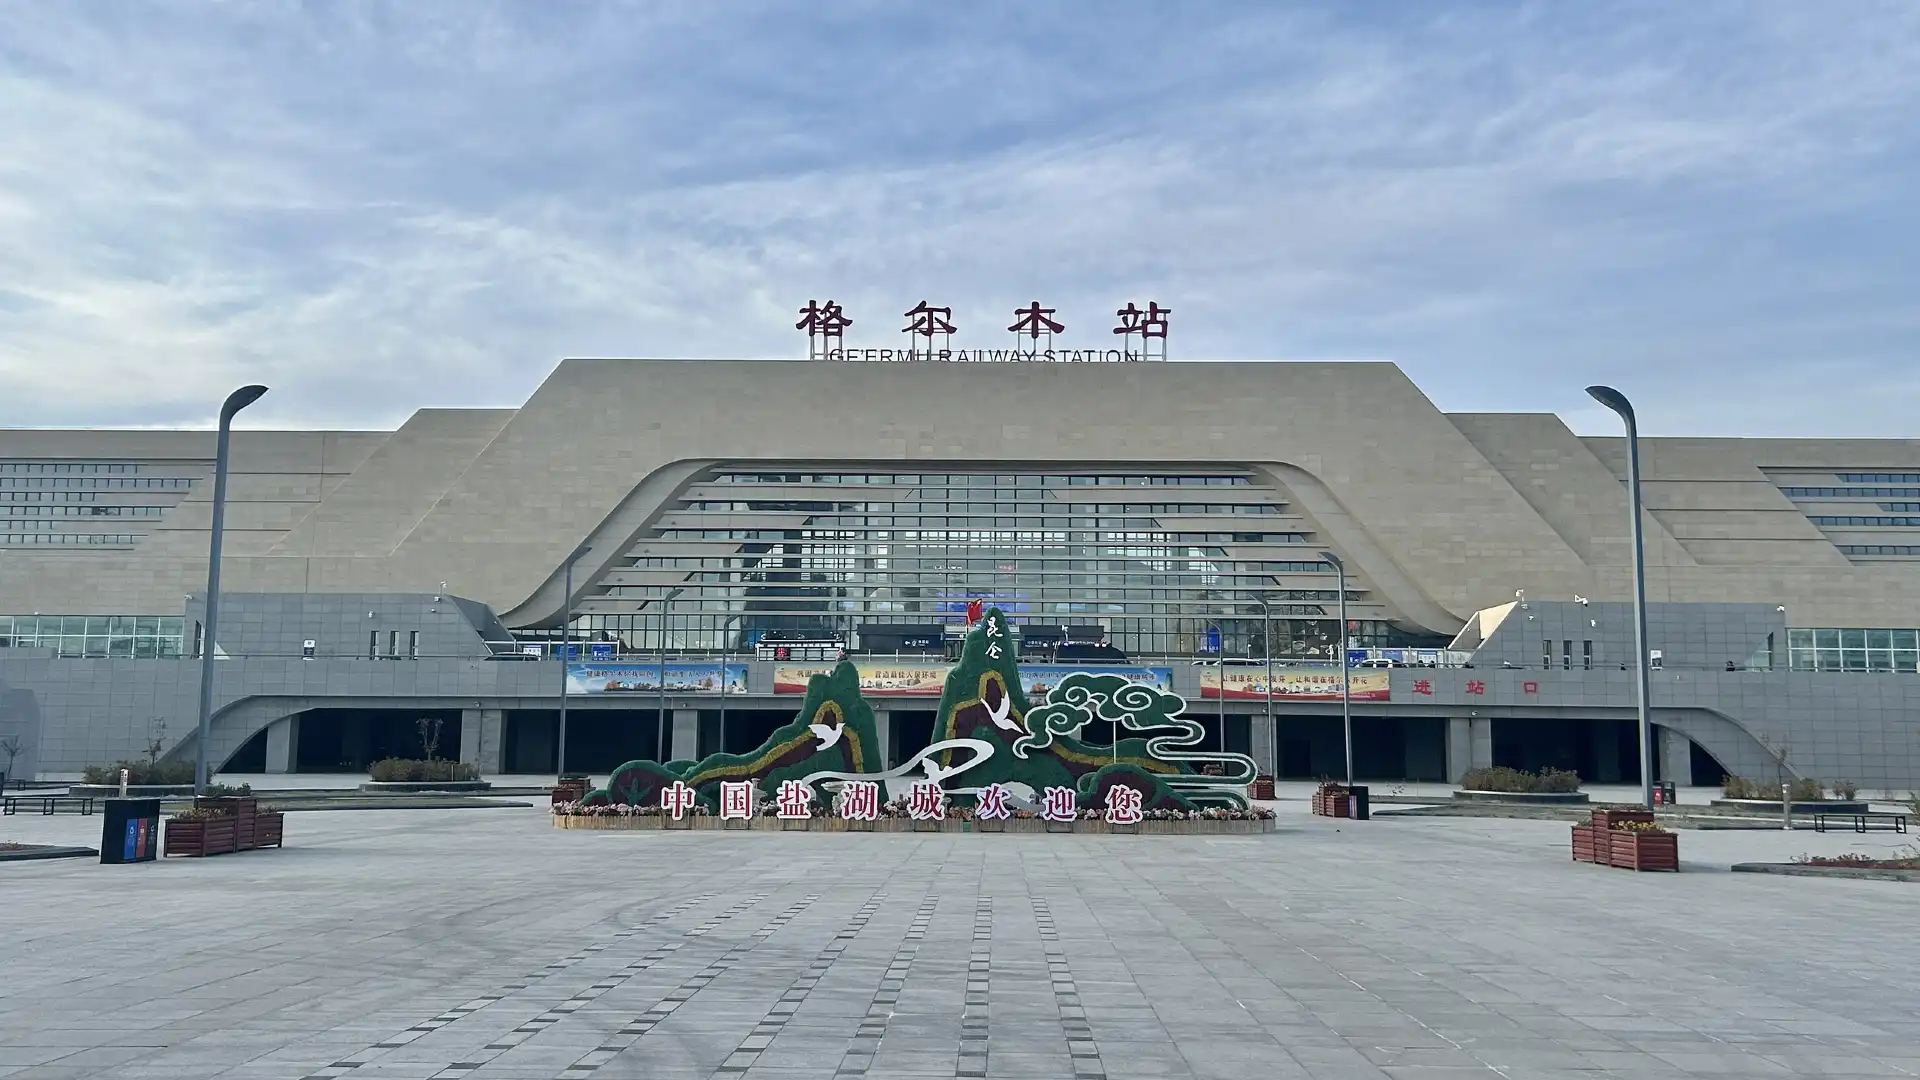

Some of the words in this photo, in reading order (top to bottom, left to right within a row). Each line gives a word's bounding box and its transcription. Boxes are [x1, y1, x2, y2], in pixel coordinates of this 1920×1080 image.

[796, 299, 1172, 339] 格尔木站
[1044, 349, 1138, 363] STATION
[984, 615, 1005, 660] 昆仑
[1295, 675, 1368, 684] 让和谐在格尔开花
[1412, 679, 1539, 695] 进站口
[661, 780, 1144, 824] 中国盐湖城欢迎您
